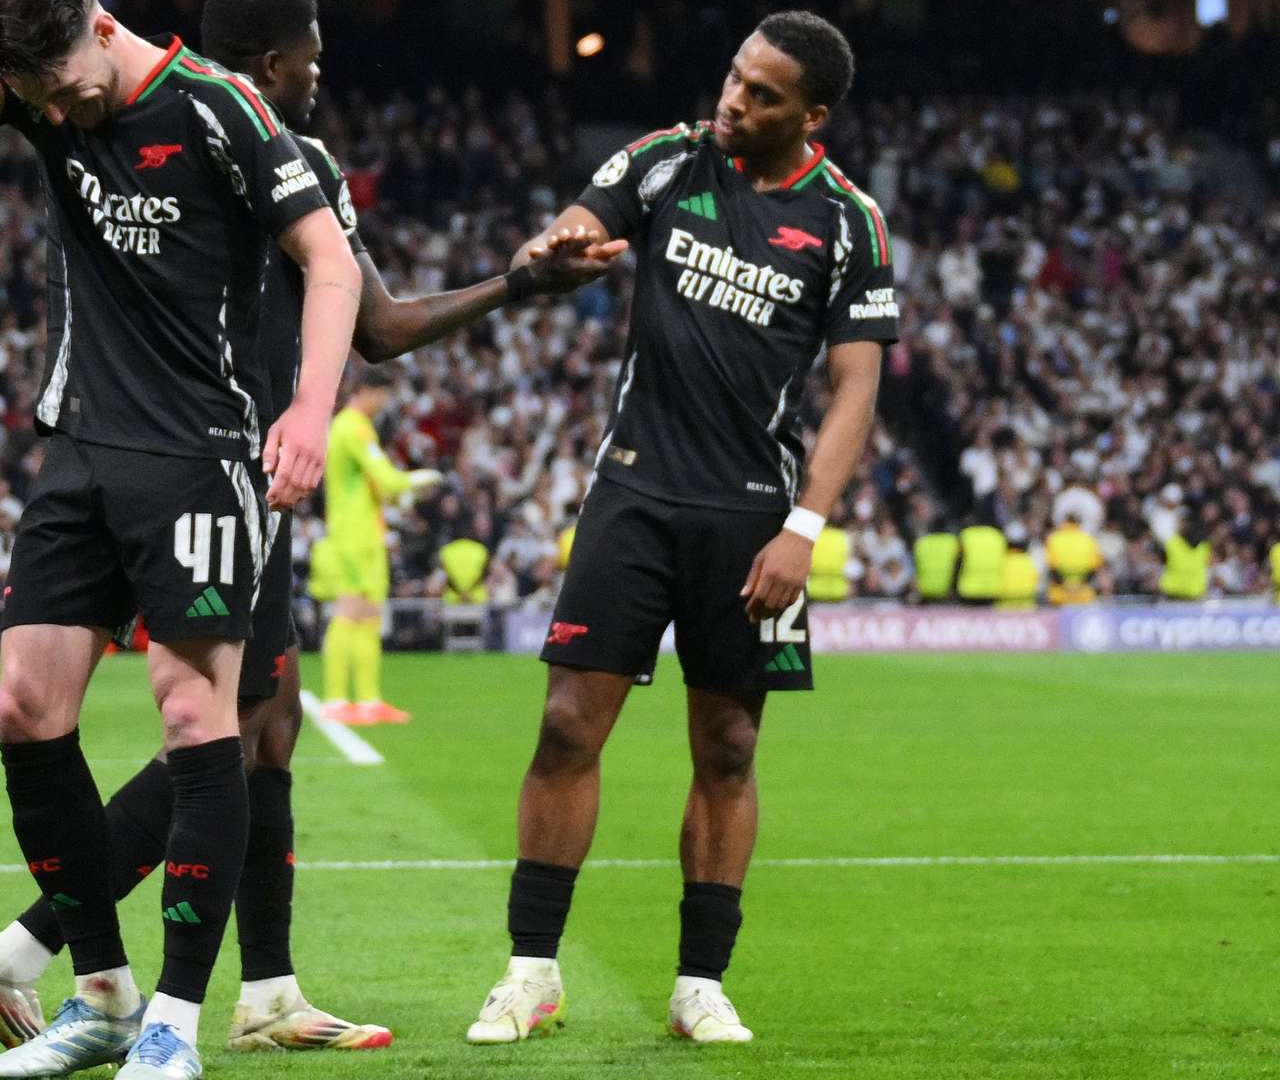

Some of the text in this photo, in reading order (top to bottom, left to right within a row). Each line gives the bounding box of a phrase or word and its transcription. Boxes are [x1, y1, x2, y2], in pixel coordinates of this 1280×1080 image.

[665, 227, 805, 303] Emirates
[677, 269, 776, 327] FLY BETTER
[174, 513, 237, 585] 41
[166, 860, 209, 880] AFC
